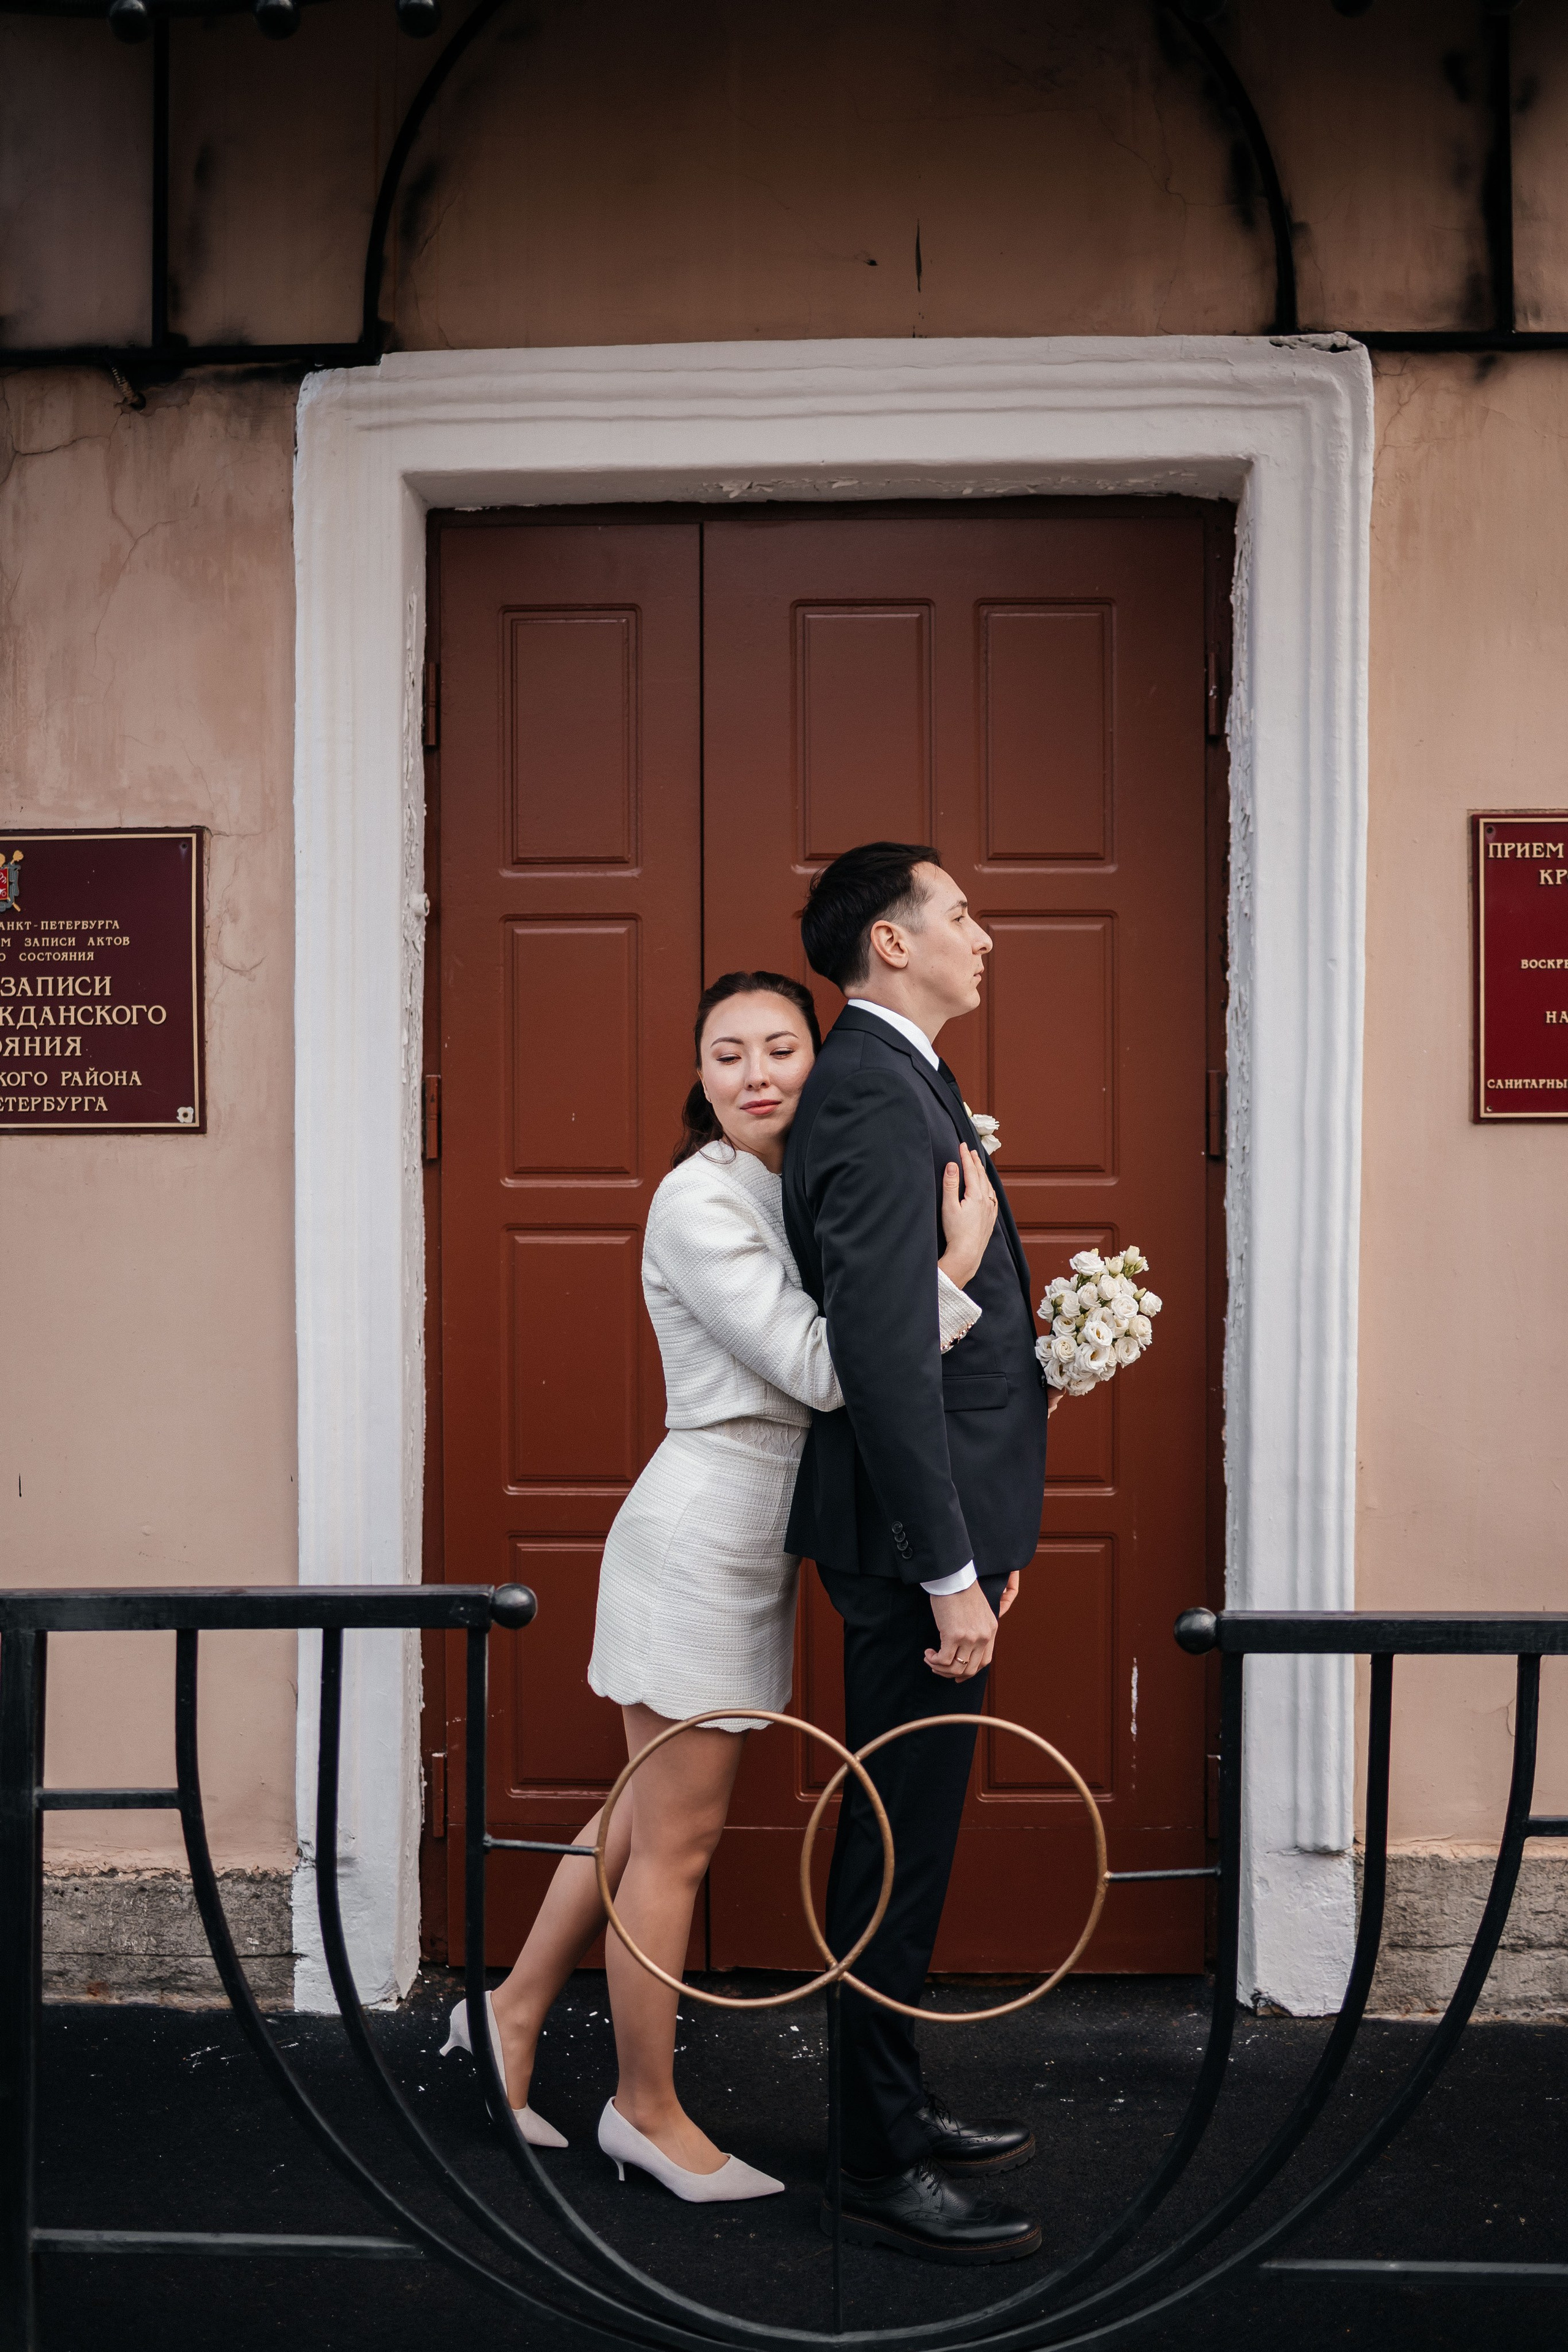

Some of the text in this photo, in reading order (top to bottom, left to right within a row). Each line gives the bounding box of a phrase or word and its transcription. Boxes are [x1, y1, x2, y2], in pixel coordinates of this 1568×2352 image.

[1488, 842, 1564, 858] ПРИЕМ
[0, 920, 119, 930] АНКТ-ПЕТЕРБУРГА
[1, 937, 130, 947] М ЗАПИСИ АКТОВ
[19, 952, 94, 961] СОСТОЯНИЯ
[0, 976, 111, 997] ЗАПИСИ
[1546, 1011, 1568, 1023] НА
[0, 1036, 81, 1057] ЯНИЯ
[61, 1067, 142, 1087] РАЙОНА
